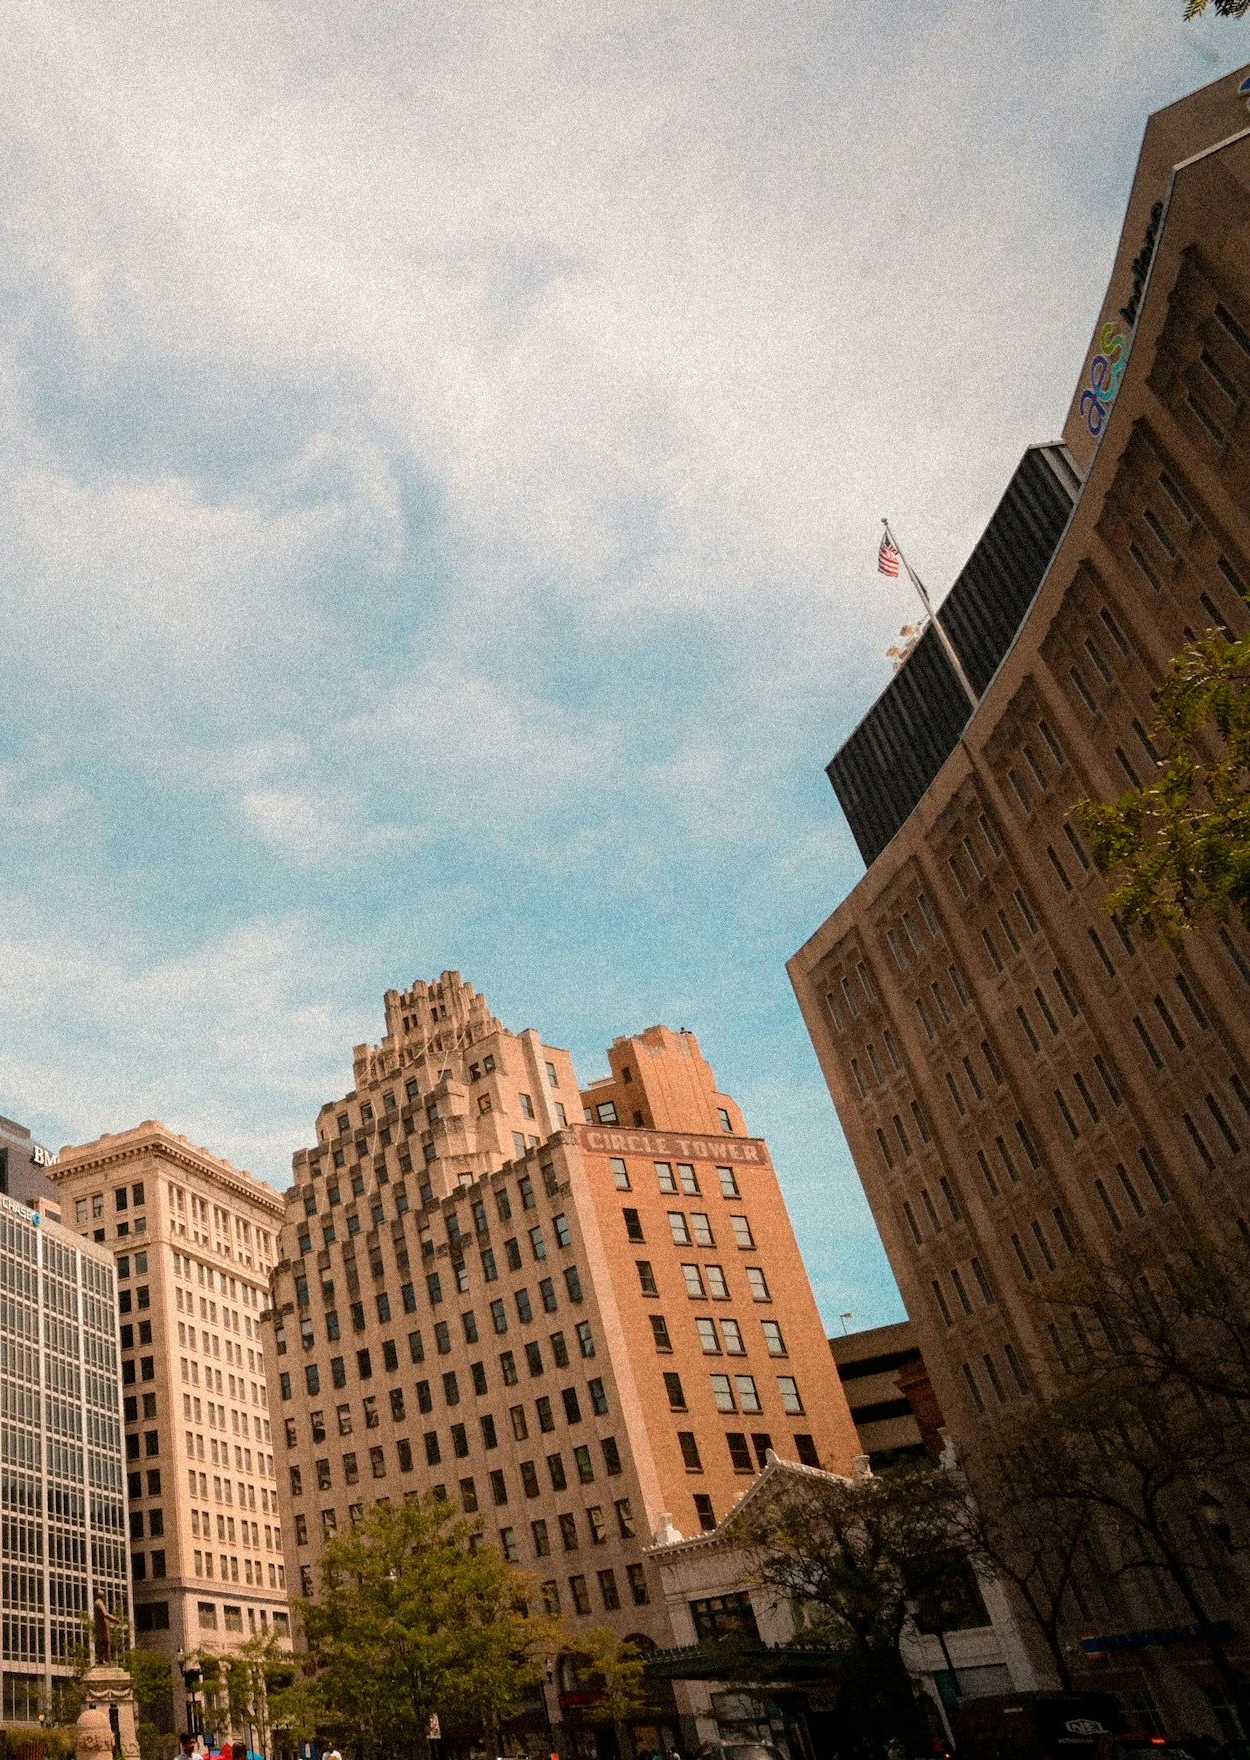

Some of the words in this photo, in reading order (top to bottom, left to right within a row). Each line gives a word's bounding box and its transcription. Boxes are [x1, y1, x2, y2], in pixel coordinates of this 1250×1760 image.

[587, 1132, 670, 1155] CIRCLE
[676, 1139, 759, 1161] TOWER
[2, 1197, 33, 1220] CHASE
